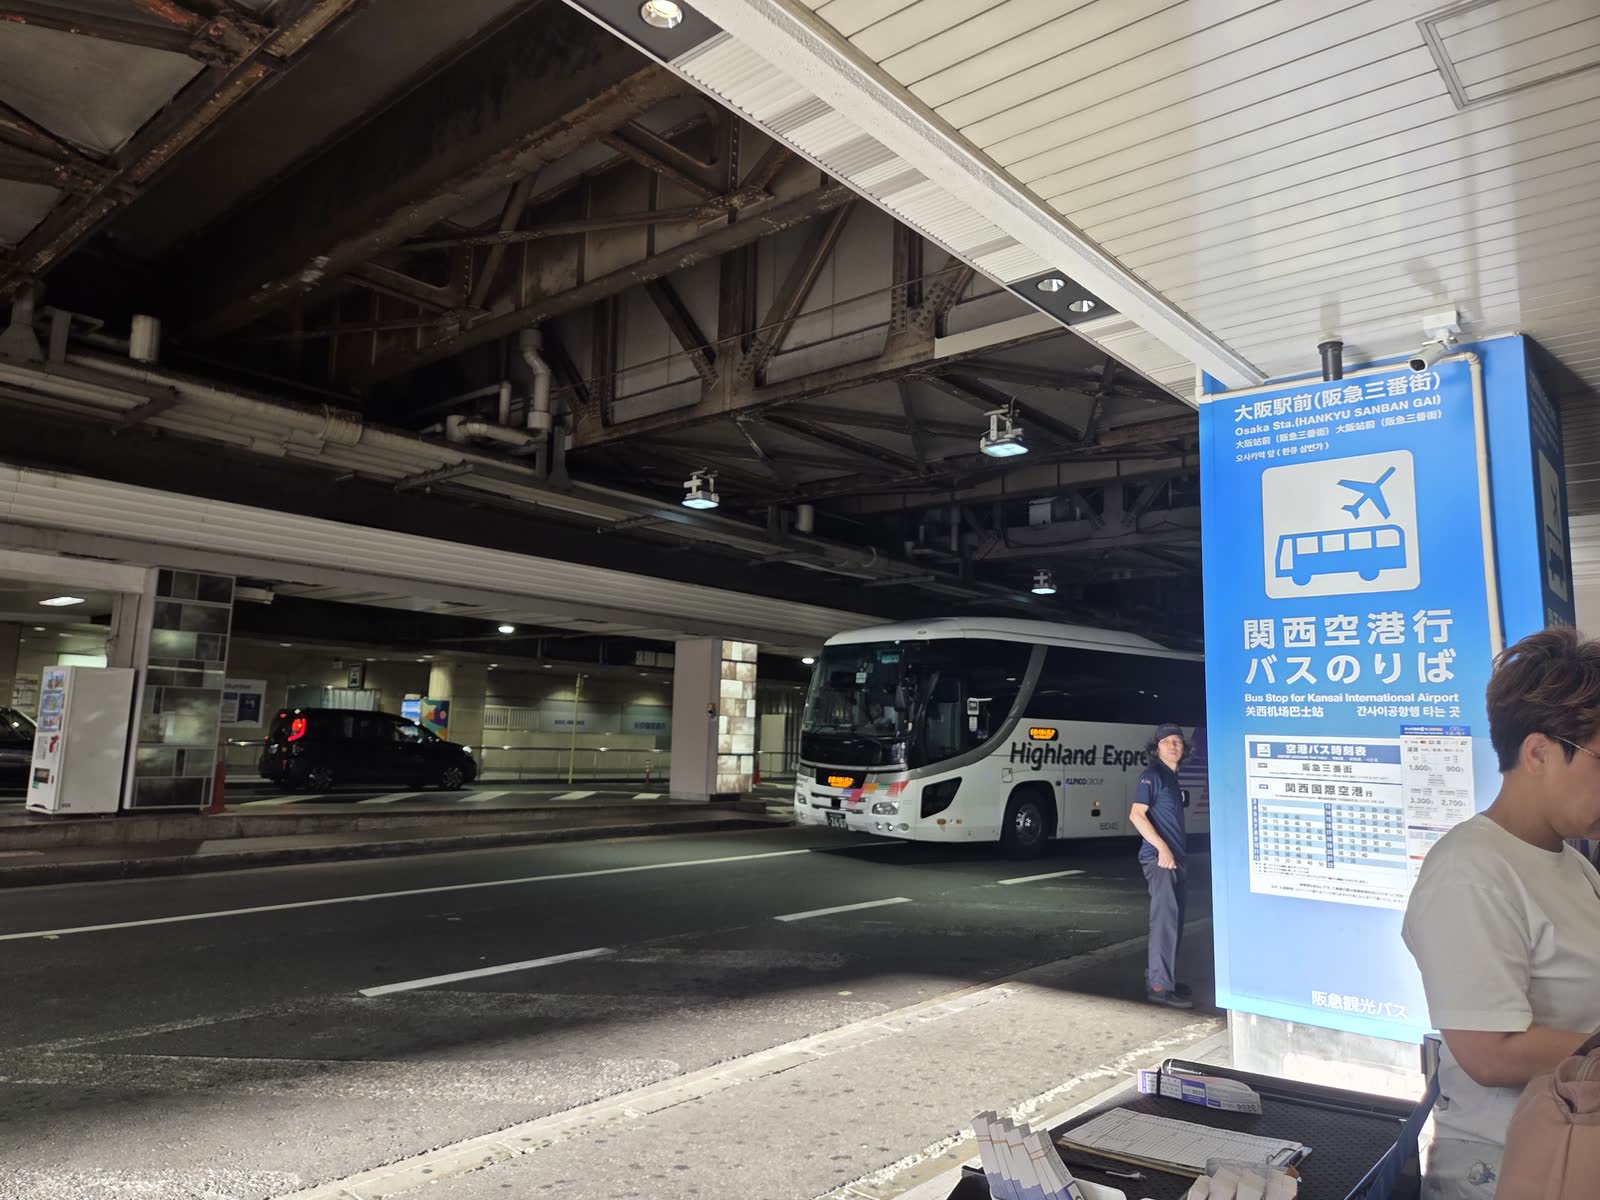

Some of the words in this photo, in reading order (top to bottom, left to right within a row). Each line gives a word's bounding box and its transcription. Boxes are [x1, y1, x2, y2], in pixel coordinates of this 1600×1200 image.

[1234, 371, 1441, 422] 大阪駅前(阪急三番街)
[1234, 424, 1270, 436] Osaka
[1272, 410, 1350, 430] Sta.(HANKYU
[1354, 401, 1409, 418] SANBAN
[1413, 395, 1441, 408] GAI)
[1244, 609, 1454, 650] 関西空港行
[1245, 648, 1457, 685] バスのりば
[1244, 694, 1263, 702] Bus
[1265, 694, 1288, 704] Stop
[1290, 694, 1306, 702] for
[1308, 694, 1343, 702] Kansai
[1345, 694, 1414, 702] International
[1418, 693, 1460, 704] Airport
[1245, 706, 1324, 718] 关西机场巴士站
[1010, 742, 1097, 771] Highland
[1103, 744, 1148, 772] Expre
[1312, 990, 1408, 1019] 阪急観光バス
